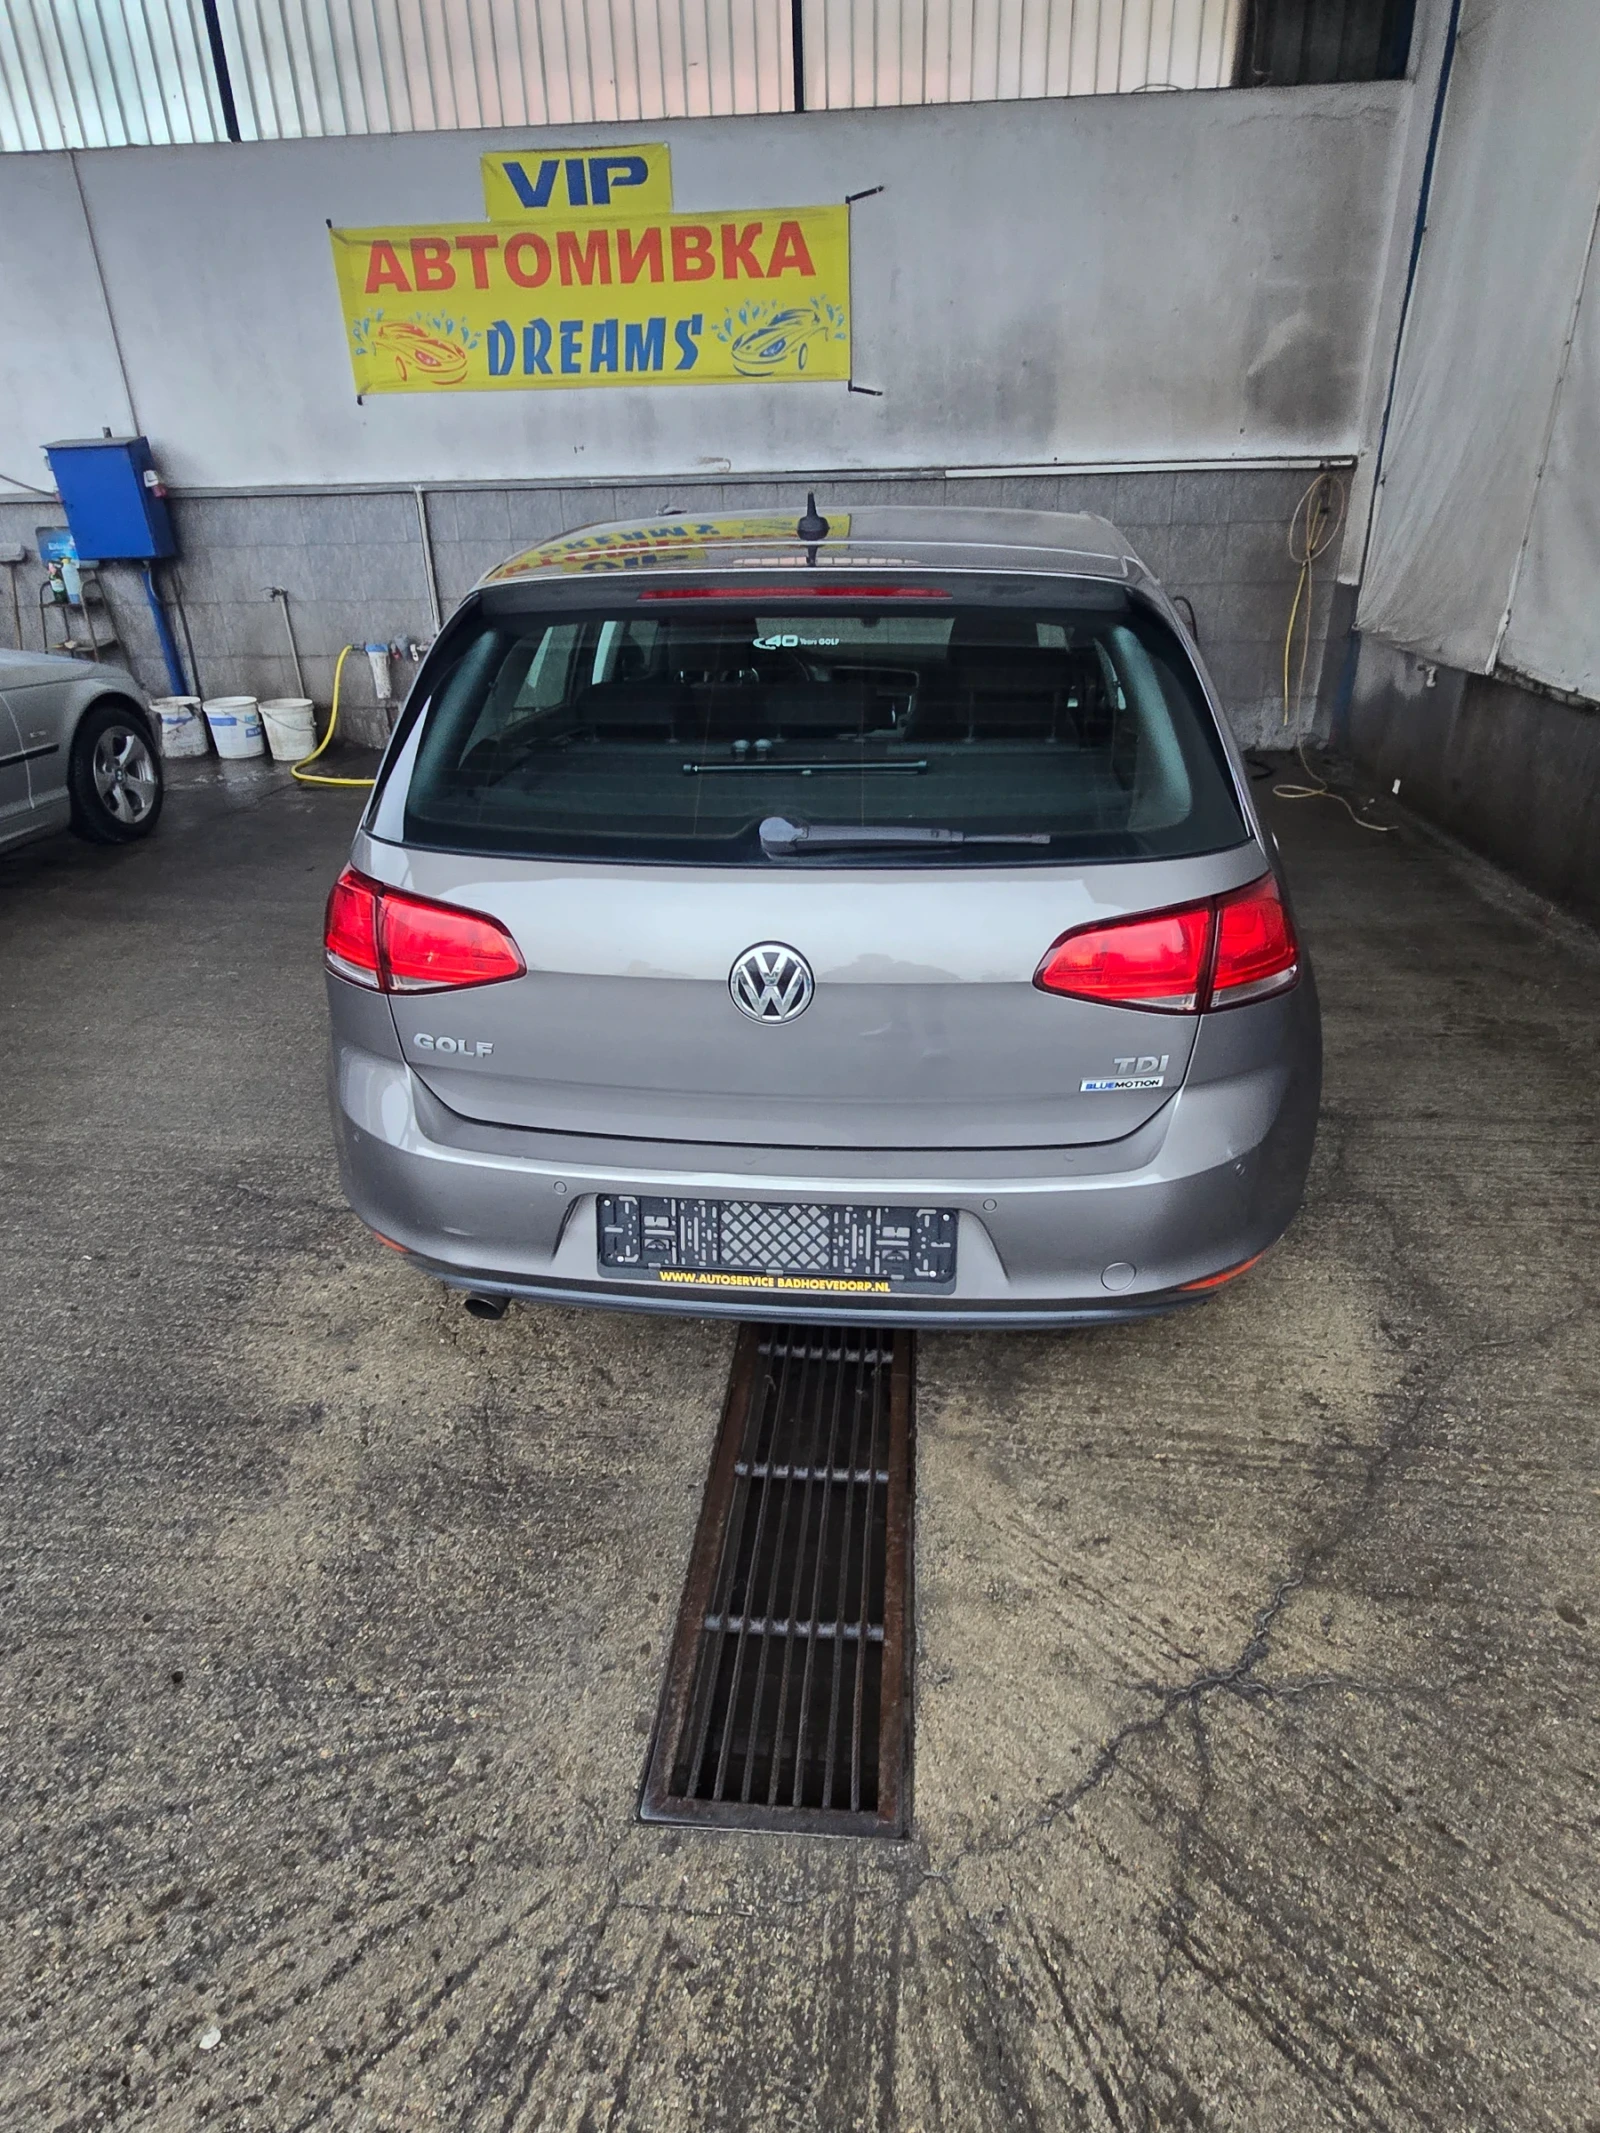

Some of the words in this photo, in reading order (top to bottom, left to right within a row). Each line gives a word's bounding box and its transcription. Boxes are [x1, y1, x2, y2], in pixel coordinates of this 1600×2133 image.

[502, 156, 649, 209] VIP
[364, 220, 817, 295] АВТОМИВКА
[486, 313, 703, 377] DREAMS
[765, 635, 798, 647] 40
[818, 638, 840, 646] GOLF
[731, 943, 813, 1021] VW
[413, 1032, 494, 1058] GOLF
[1113, 1054, 1170, 1075] TDI
[1085, 1079, 1160, 1090] BLUEMOTION
[659, 1271, 775, 1288] WWW.AUTOSERVICE
[777, 1277, 892, 1293] BADHOEVEDORP.NL
